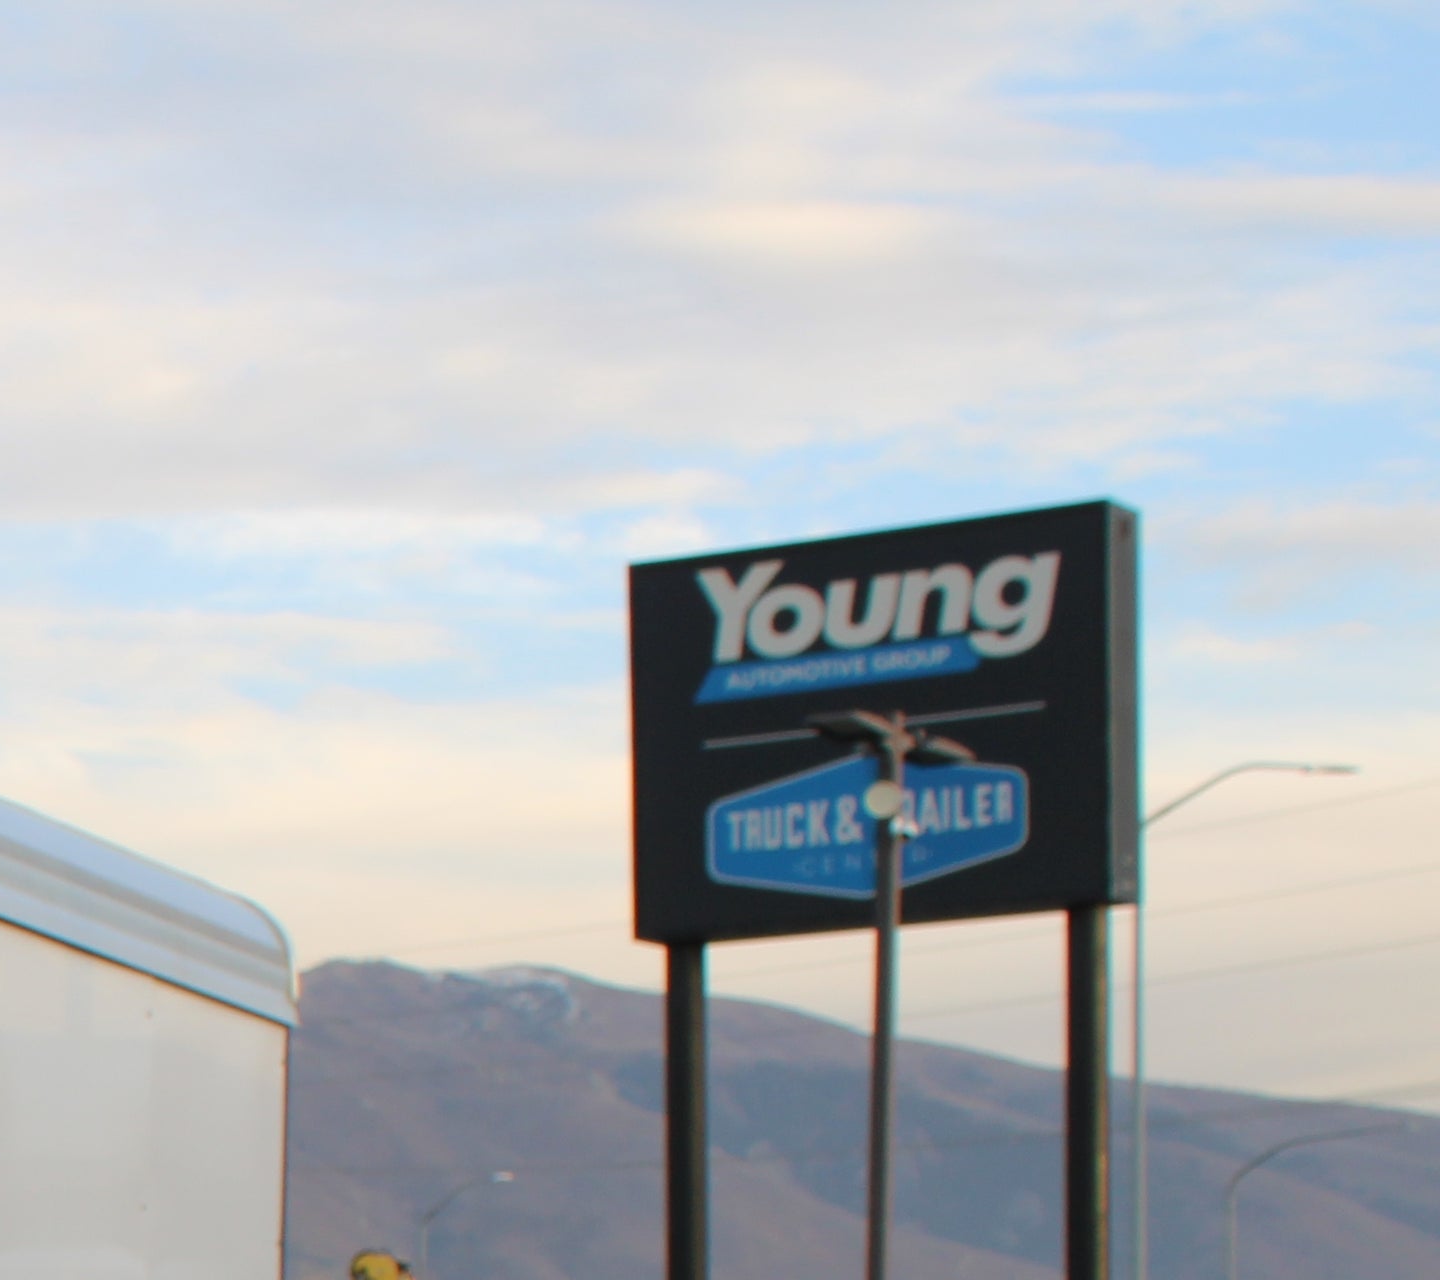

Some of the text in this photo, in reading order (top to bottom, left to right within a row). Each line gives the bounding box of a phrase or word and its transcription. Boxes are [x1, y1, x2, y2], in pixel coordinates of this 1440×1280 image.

[696, 551, 1061, 661] Young
[726, 645, 952, 690] AUTOMOTIVE GROUP
[727, 780, 1015, 852] TRUCK & RAILER
